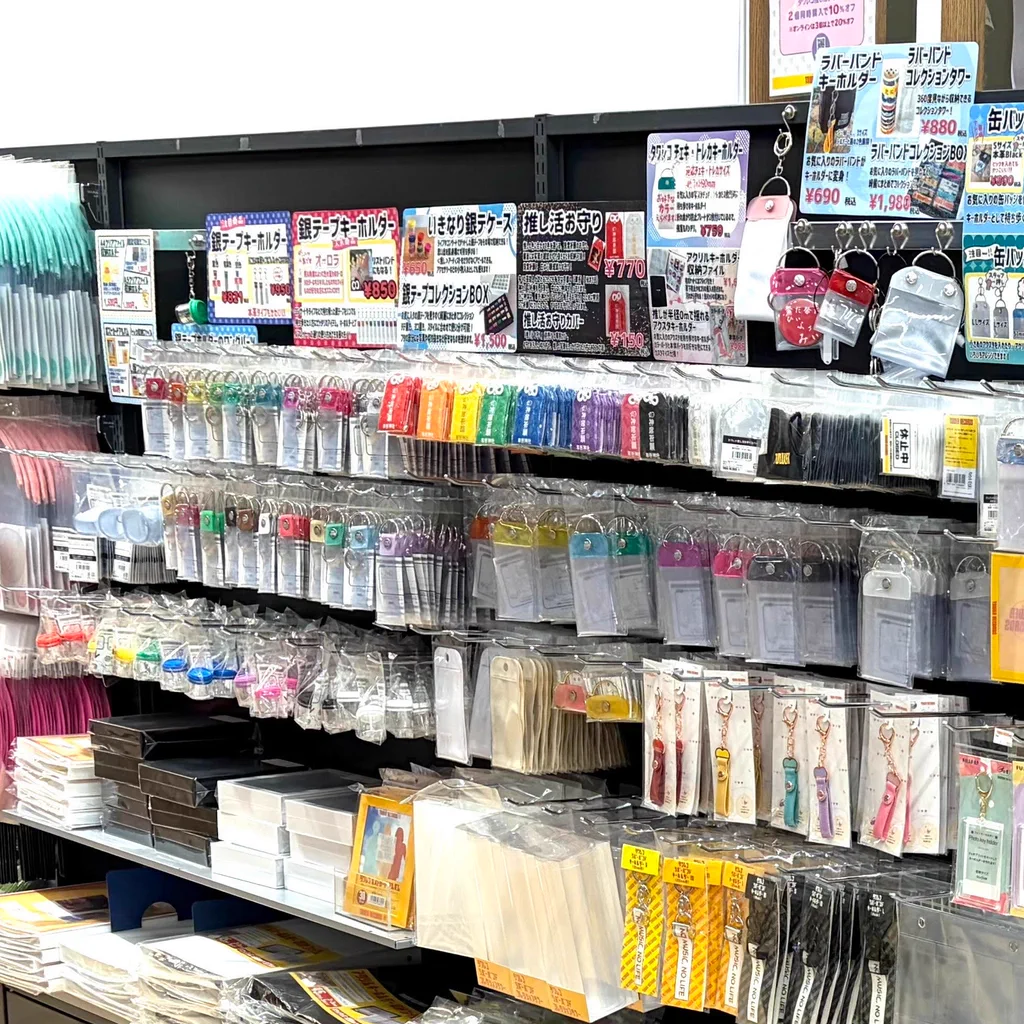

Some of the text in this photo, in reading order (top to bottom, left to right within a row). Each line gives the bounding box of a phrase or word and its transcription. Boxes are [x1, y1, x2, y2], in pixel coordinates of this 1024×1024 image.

[821, 52, 882, 70] ラバーバンド
[908, 46, 952, 65] ラバーバンド
[818, 73, 877, 90] キーホルダー
[906, 68, 970, 87] コレクションタワー
[921, 120, 956, 136] ¥880
[805, 188, 840, 204] ¥690
[298, 214, 395, 241] 銀テープキーホルダー
[428, 212, 516, 237] いきなり銀テケース
[524, 210, 602, 234] 推し活お守り
[212, 231, 287, 252] 銀テープキーホルダー
[605, 260, 646, 278] ¥770
[364, 281, 397, 299] ¥850
[402, 282, 490, 307] 銀テープコレクションBOX
[474, 334, 507, 348] ¥1,500
[610, 332, 644, 348] ¥150
[900, 428, 909, 464] 休止中
[682, 966, 688, 978] NO
